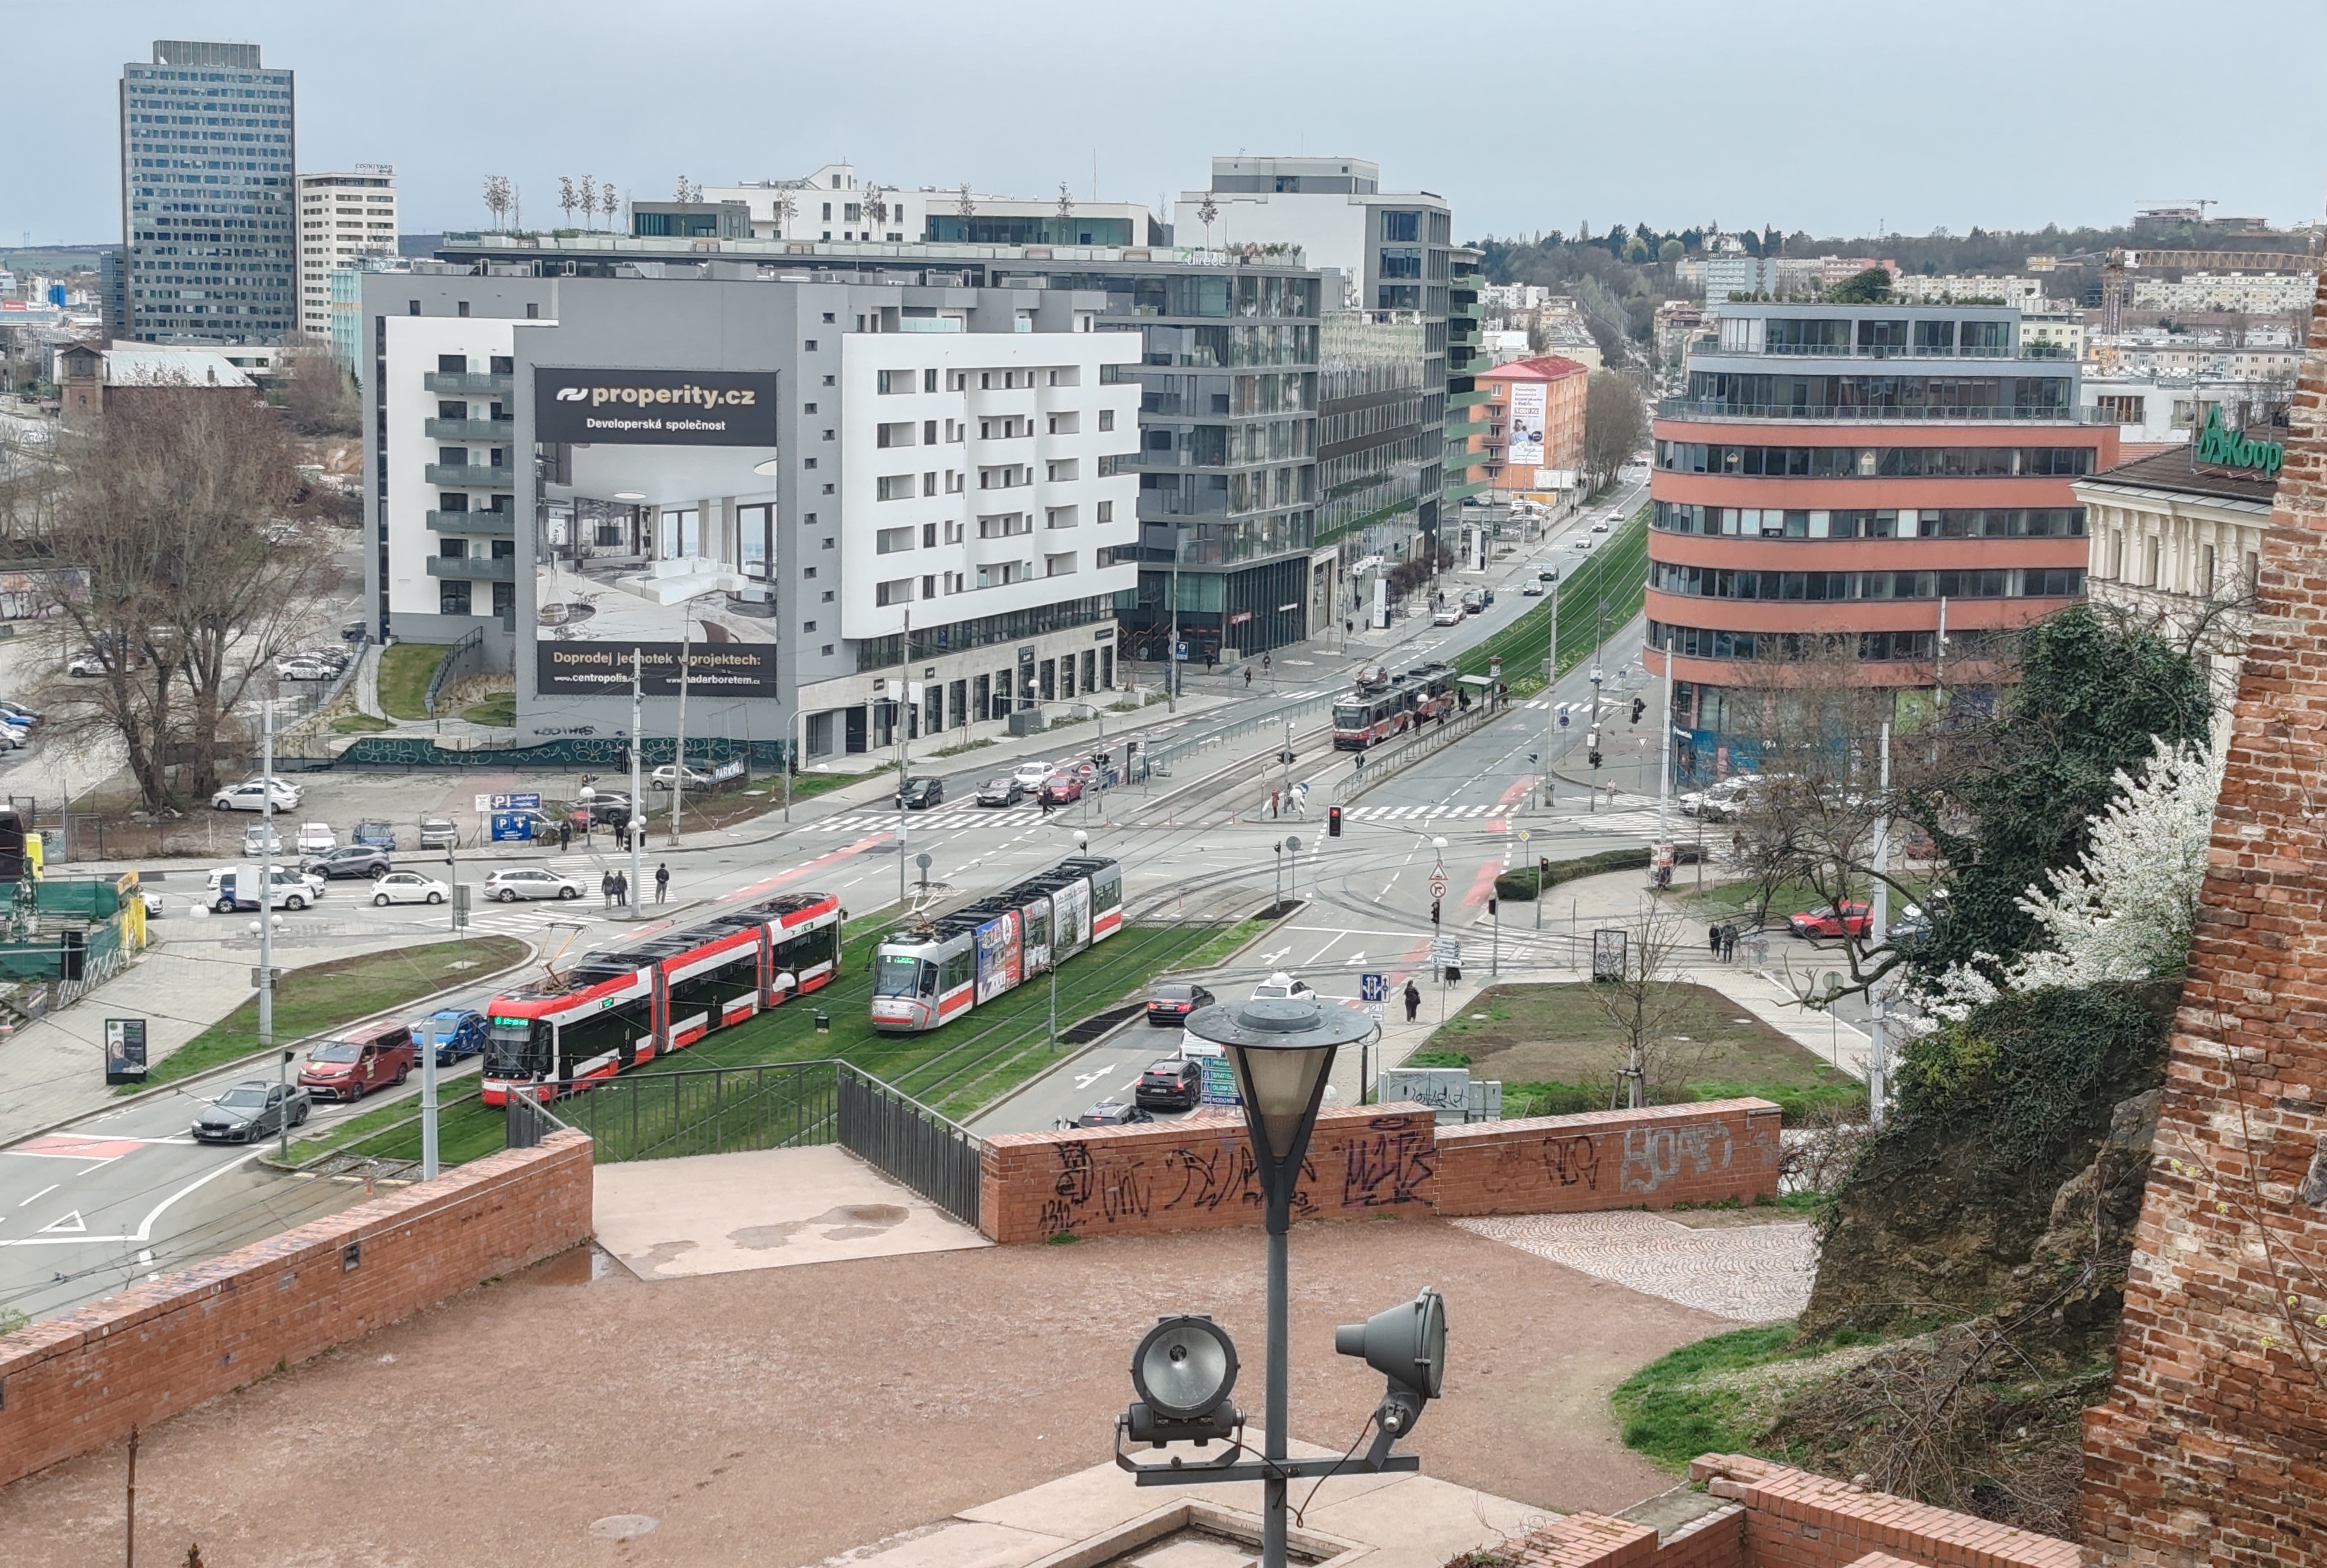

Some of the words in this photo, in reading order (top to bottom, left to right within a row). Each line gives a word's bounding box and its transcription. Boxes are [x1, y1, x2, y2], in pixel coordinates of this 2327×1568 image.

[1187, 252, 1225, 266] direct
[592, 384, 756, 409] properity.cz
[586, 418, 662, 430] Developerská
[665, 420, 726, 431] společnost
[553, 652, 613, 666] Doprodej
[689, 654, 761, 666] projektech:
